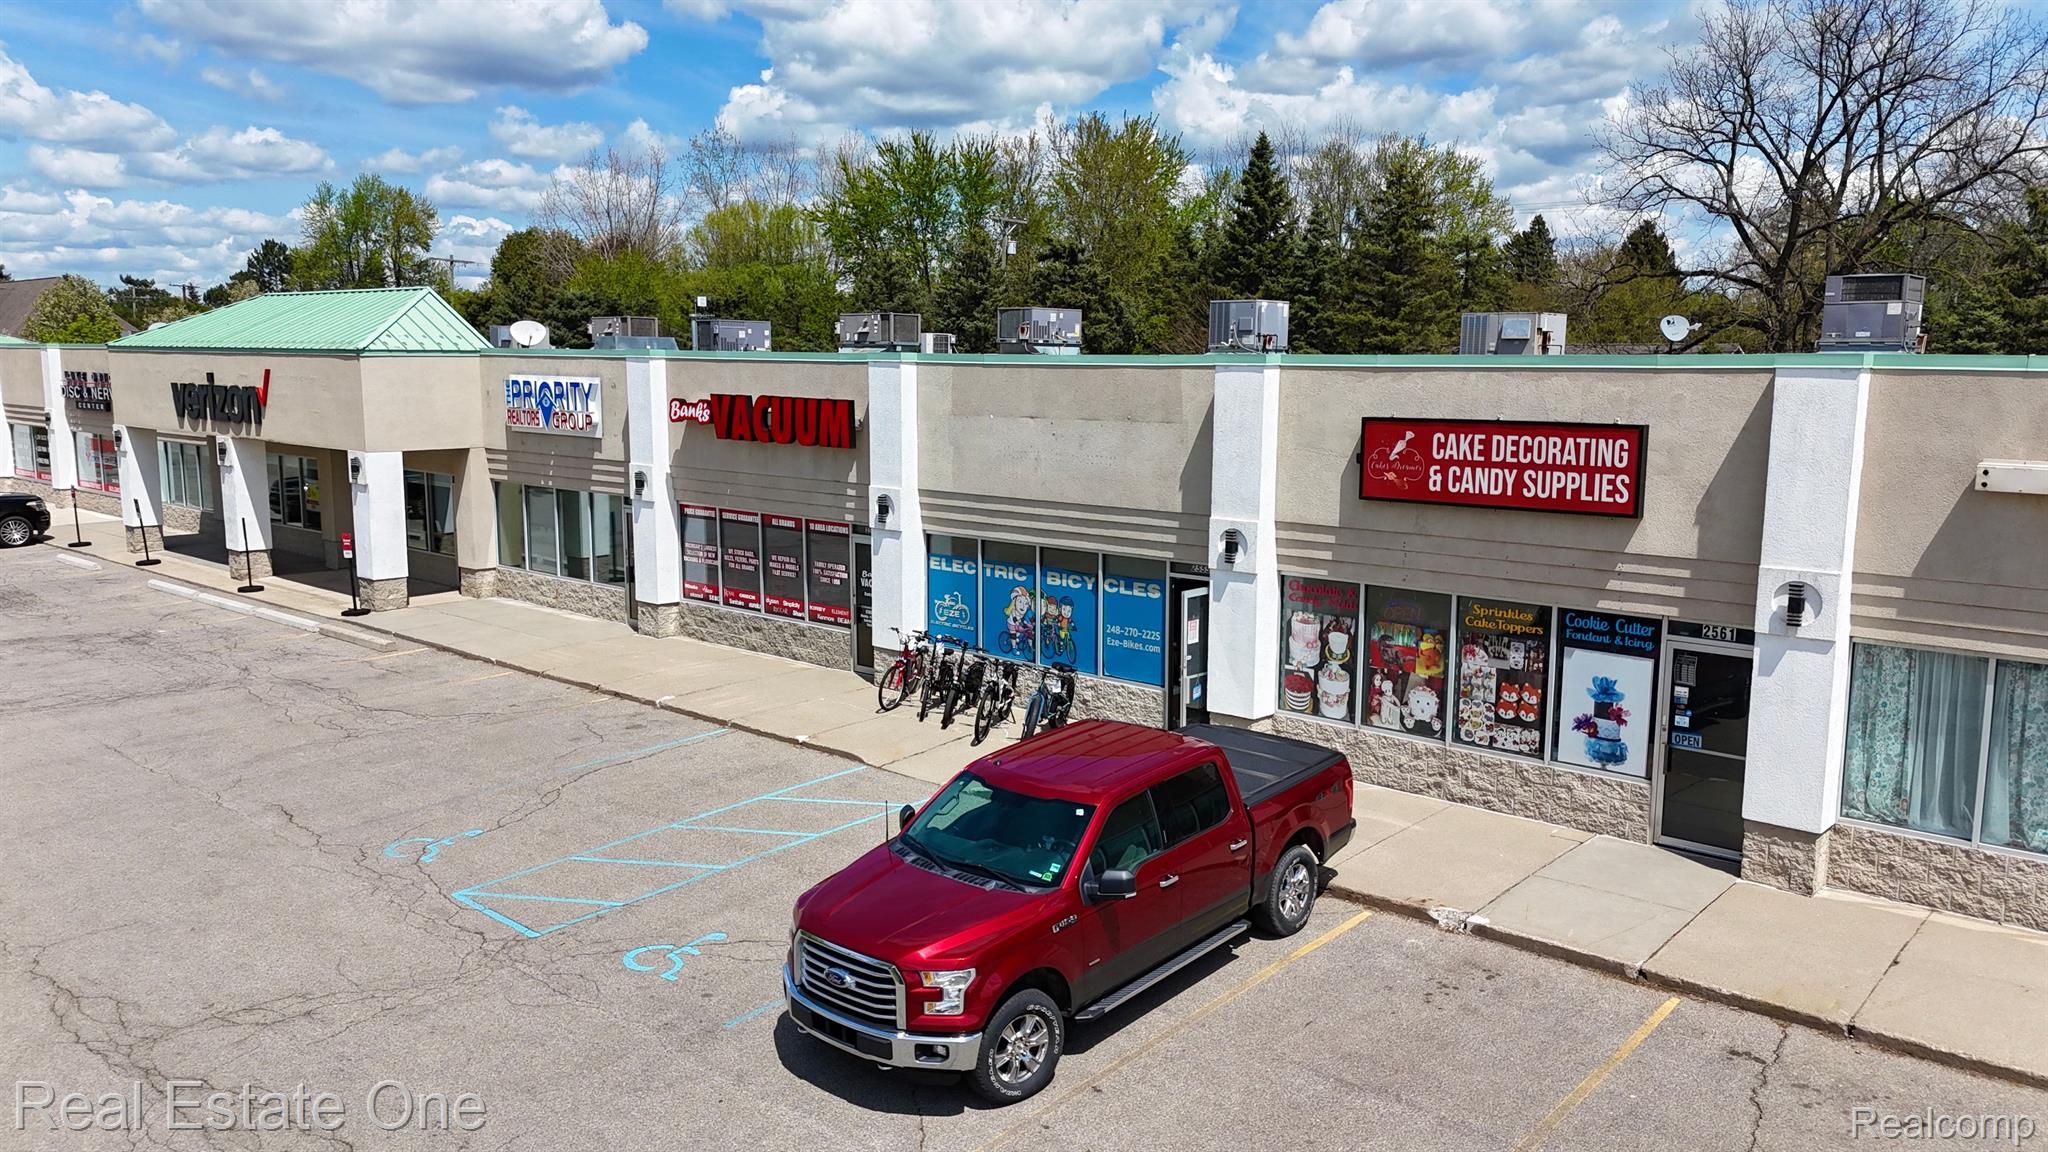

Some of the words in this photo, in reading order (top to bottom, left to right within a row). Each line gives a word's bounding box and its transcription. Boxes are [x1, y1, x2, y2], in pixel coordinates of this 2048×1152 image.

[61, 385, 80, 398] DISC
[91, 387, 113, 400] NERV
[171, 372, 263, 424] verizon
[511, 379, 592, 411] PRIORITY
[78, 402, 104, 410] CENTER
[507, 410, 540, 426] REALTORS
[553, 412, 592, 430] GROUP
[670, 400, 710, 422] Bank's
[710, 394, 855, 448] VACUUM
[1432, 432, 1486, 461] CAKE
[1491, 434, 1629, 468] DECORATING
[1429, 465, 1442, 492] &
[1448, 467, 1517, 496] CANDY
[1522, 470, 1630, 503] SUPPLIES
[722, 512, 737, 520] SERVICE
[779, 519, 795, 528] BRANDS
[825, 525, 848, 534] LOCATIONS
[778, 555, 789, 563] REPAIR
[827, 562, 846, 571] OPERATED
[823, 569, 848, 579] SATISFACTION
[929, 556, 1028, 582] ELECTRIC
[1046, 571, 1161, 599] BICYCLES
[1288, 579, 1344, 597] Chocolate
[944, 609, 960, 618] EZE
[1472, 604, 1534, 623] Sprinkles
[1106, 624, 1161, 641] 248-270-2225
[1465, 616, 1497, 629] Cake
[1495, 618, 1544, 635] Toppers
[1566, 612, 1610, 631] Cookie
[1616, 618, 1655, 637] Cutter
[1703, 625, 1735, 640] 2561
[1106, 637, 1161, 654] Eze-Bikes.com
[1566, 629, 1611, 644] Fondant
[1614, 636, 1623, 646] &
[1624, 636, 1655, 652] Icing
[1674, 734, 1701, 747] OPEN
